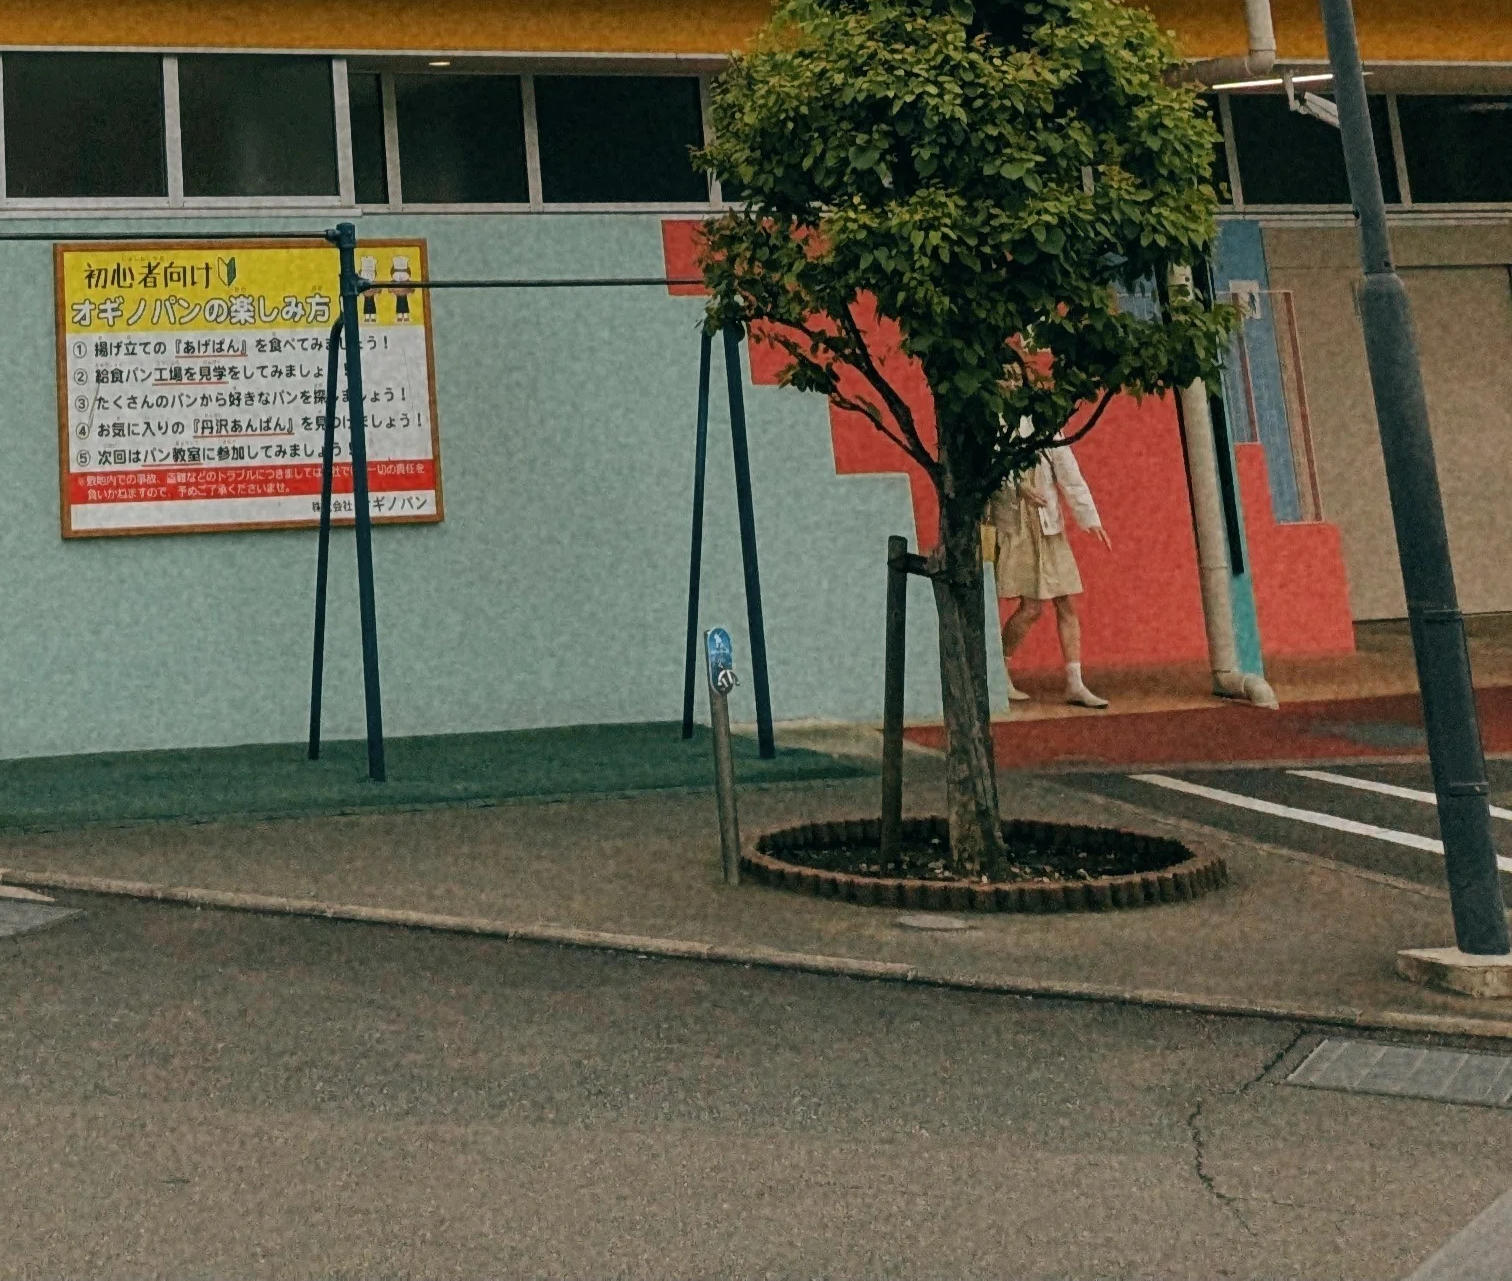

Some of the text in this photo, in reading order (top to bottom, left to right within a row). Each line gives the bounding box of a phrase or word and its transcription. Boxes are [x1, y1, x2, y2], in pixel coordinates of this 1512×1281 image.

[84, 261, 213, 289] 初心者向け
